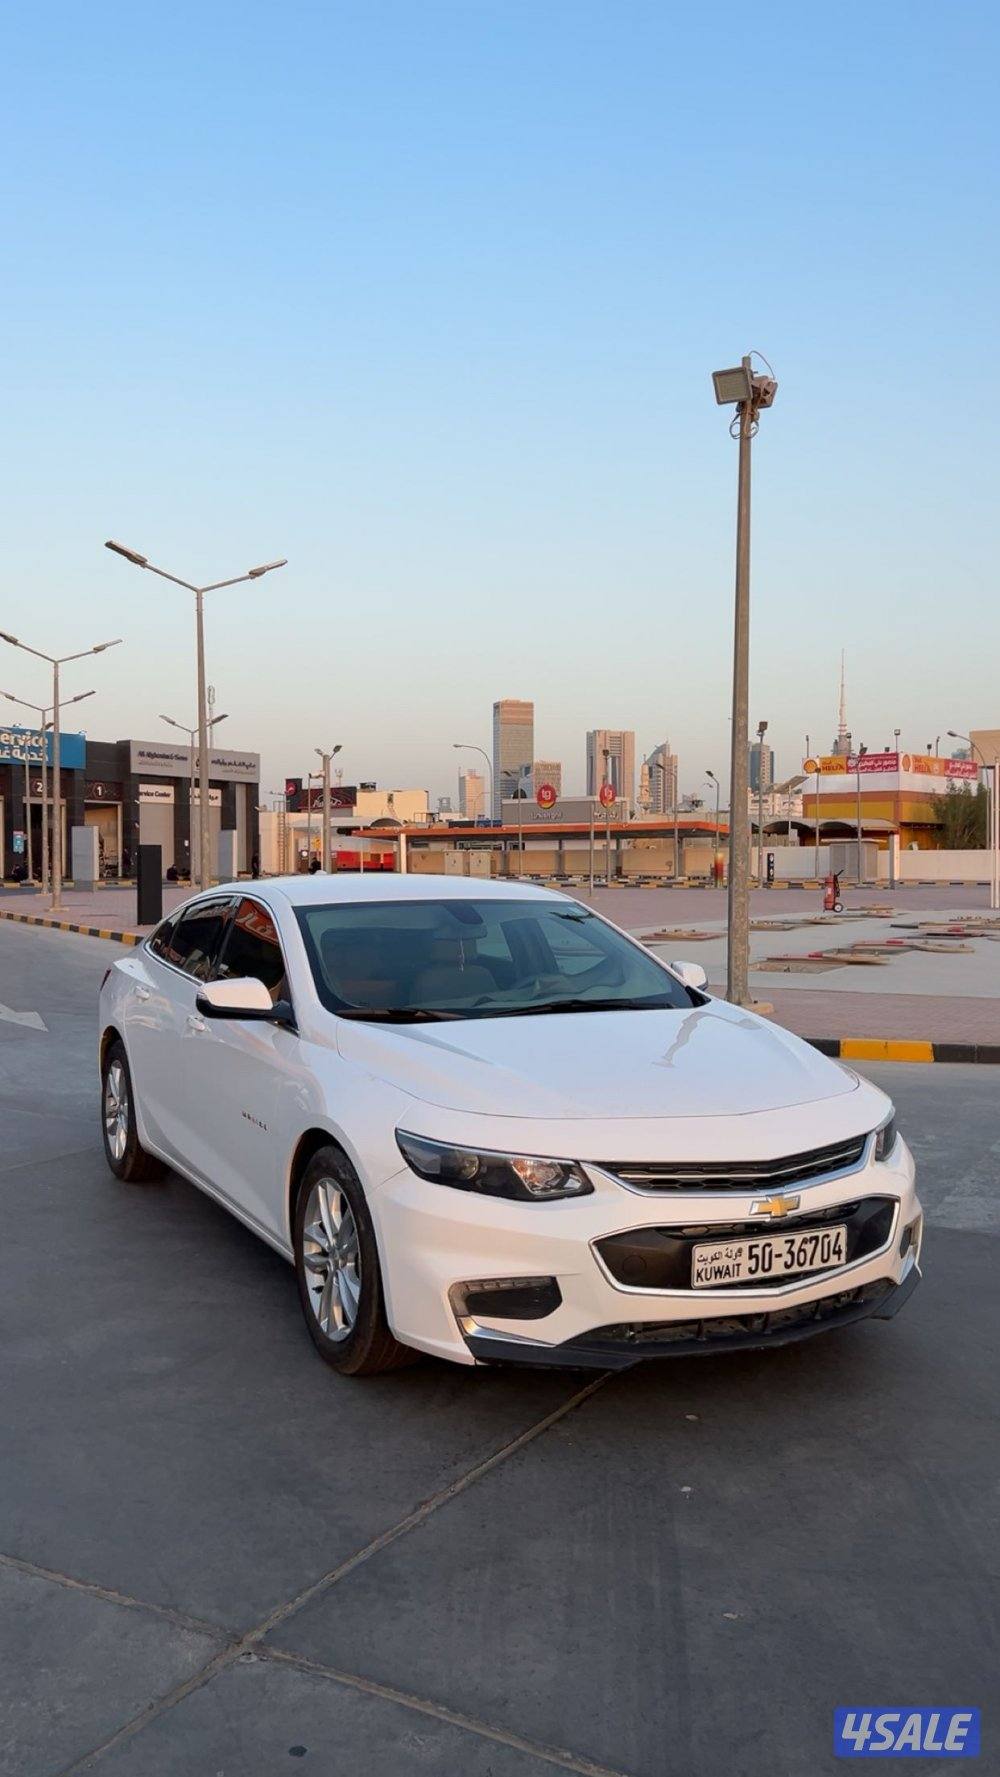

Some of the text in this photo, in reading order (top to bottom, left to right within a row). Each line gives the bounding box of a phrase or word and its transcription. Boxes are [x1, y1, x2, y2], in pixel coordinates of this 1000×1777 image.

[0, 730, 49, 747] ervice
[36, 782, 44, 793] 2
[96, 786, 103, 797] 1
[697, 1252, 723, 1265] الكويت
[747, 1231, 843, 1275] 50-36704
[696, 1263, 742, 1283] KUWAIT
